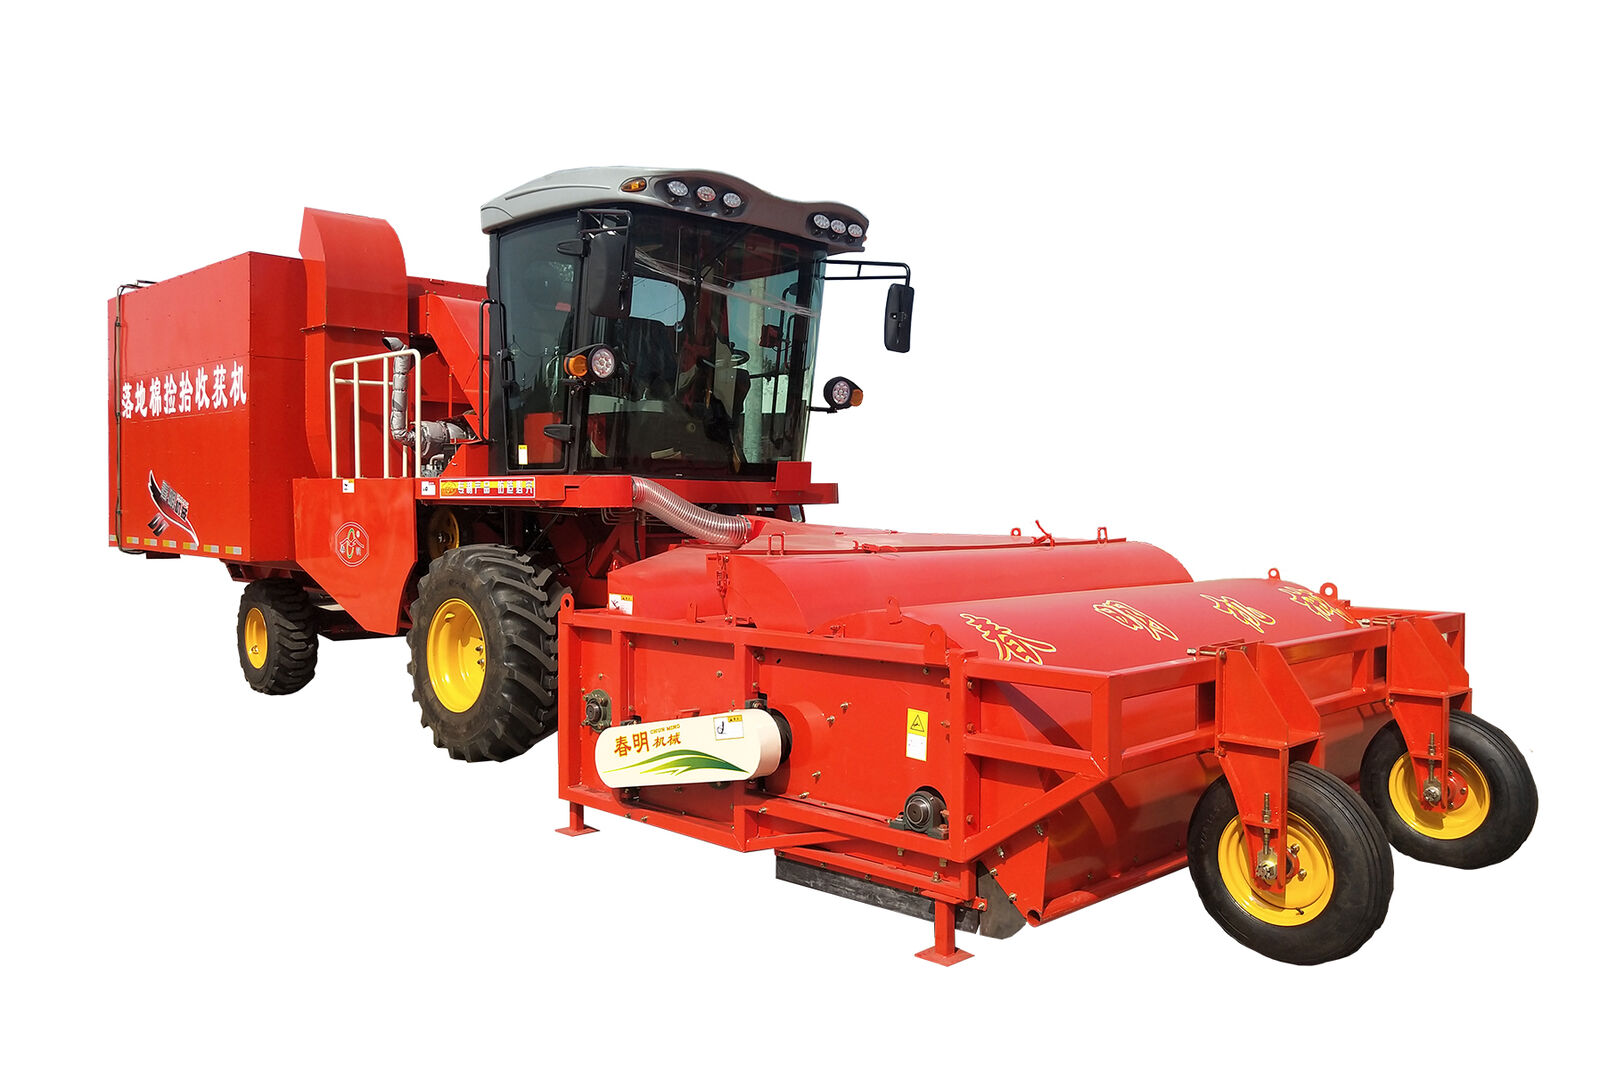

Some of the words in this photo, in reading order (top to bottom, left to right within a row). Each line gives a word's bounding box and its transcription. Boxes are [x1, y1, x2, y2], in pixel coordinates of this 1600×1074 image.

[121, 360, 247, 419] 落地棉捡拾收获机
[614, 731, 650, 757] 春明
[652, 731, 682, 748] 机械
